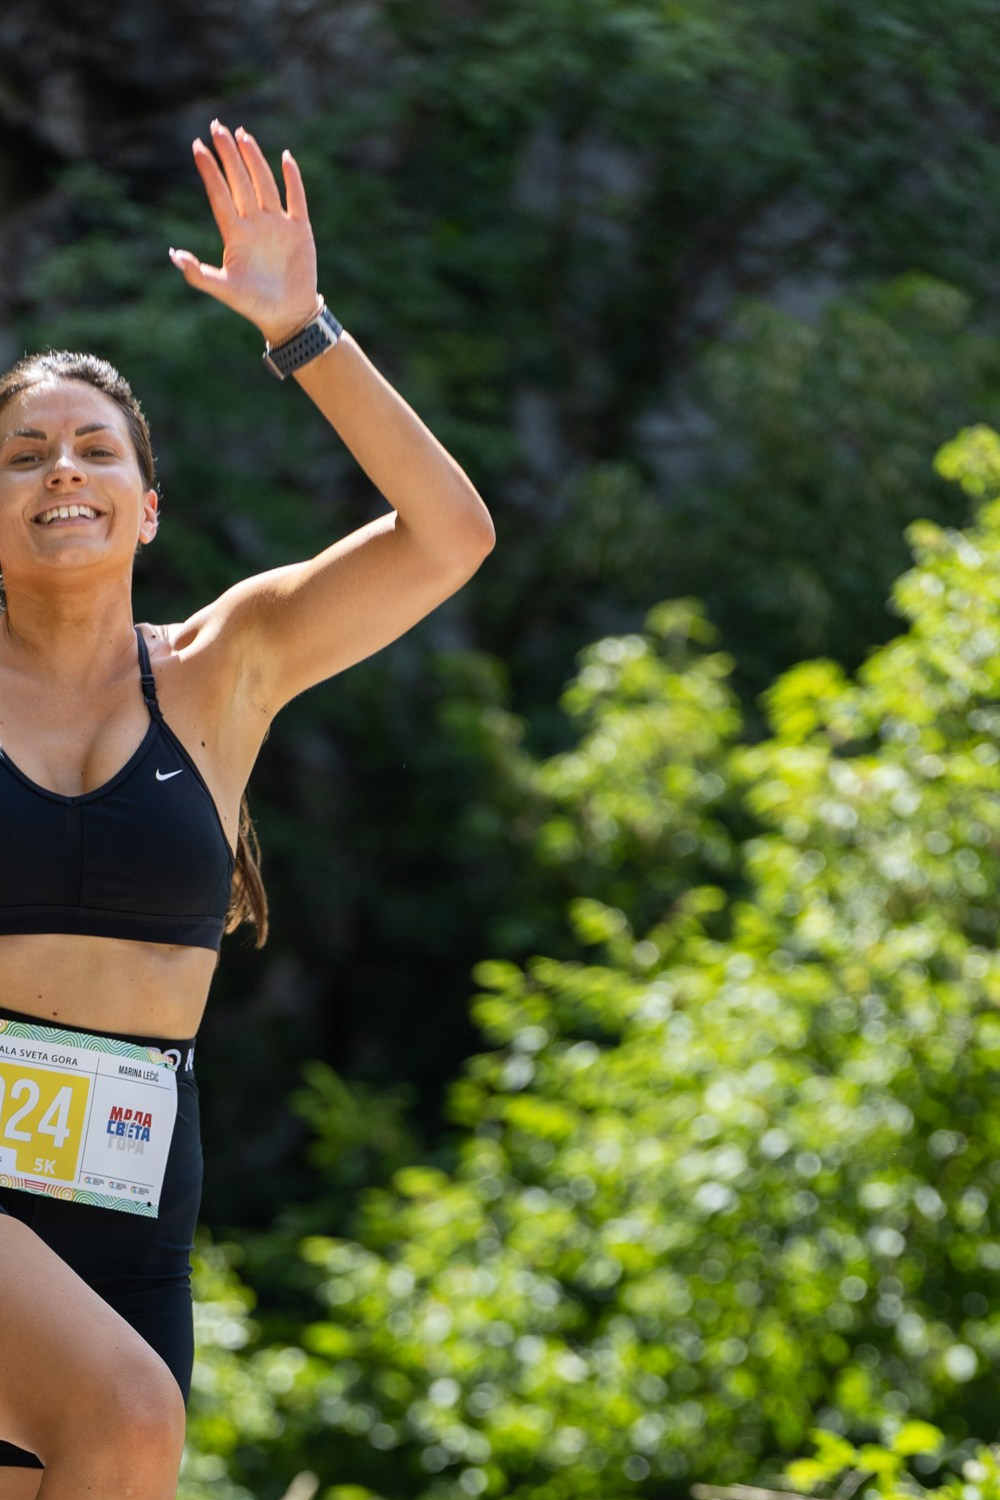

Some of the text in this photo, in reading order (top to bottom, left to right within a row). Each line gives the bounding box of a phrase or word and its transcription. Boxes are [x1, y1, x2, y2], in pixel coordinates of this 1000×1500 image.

[19, 1048, 48, 1061] SVETA
[50, 1054, 78, 1066] GORA
[118, 1065, 143, 1079] MARINA
[33, 1158, 57, 1174] 5K
